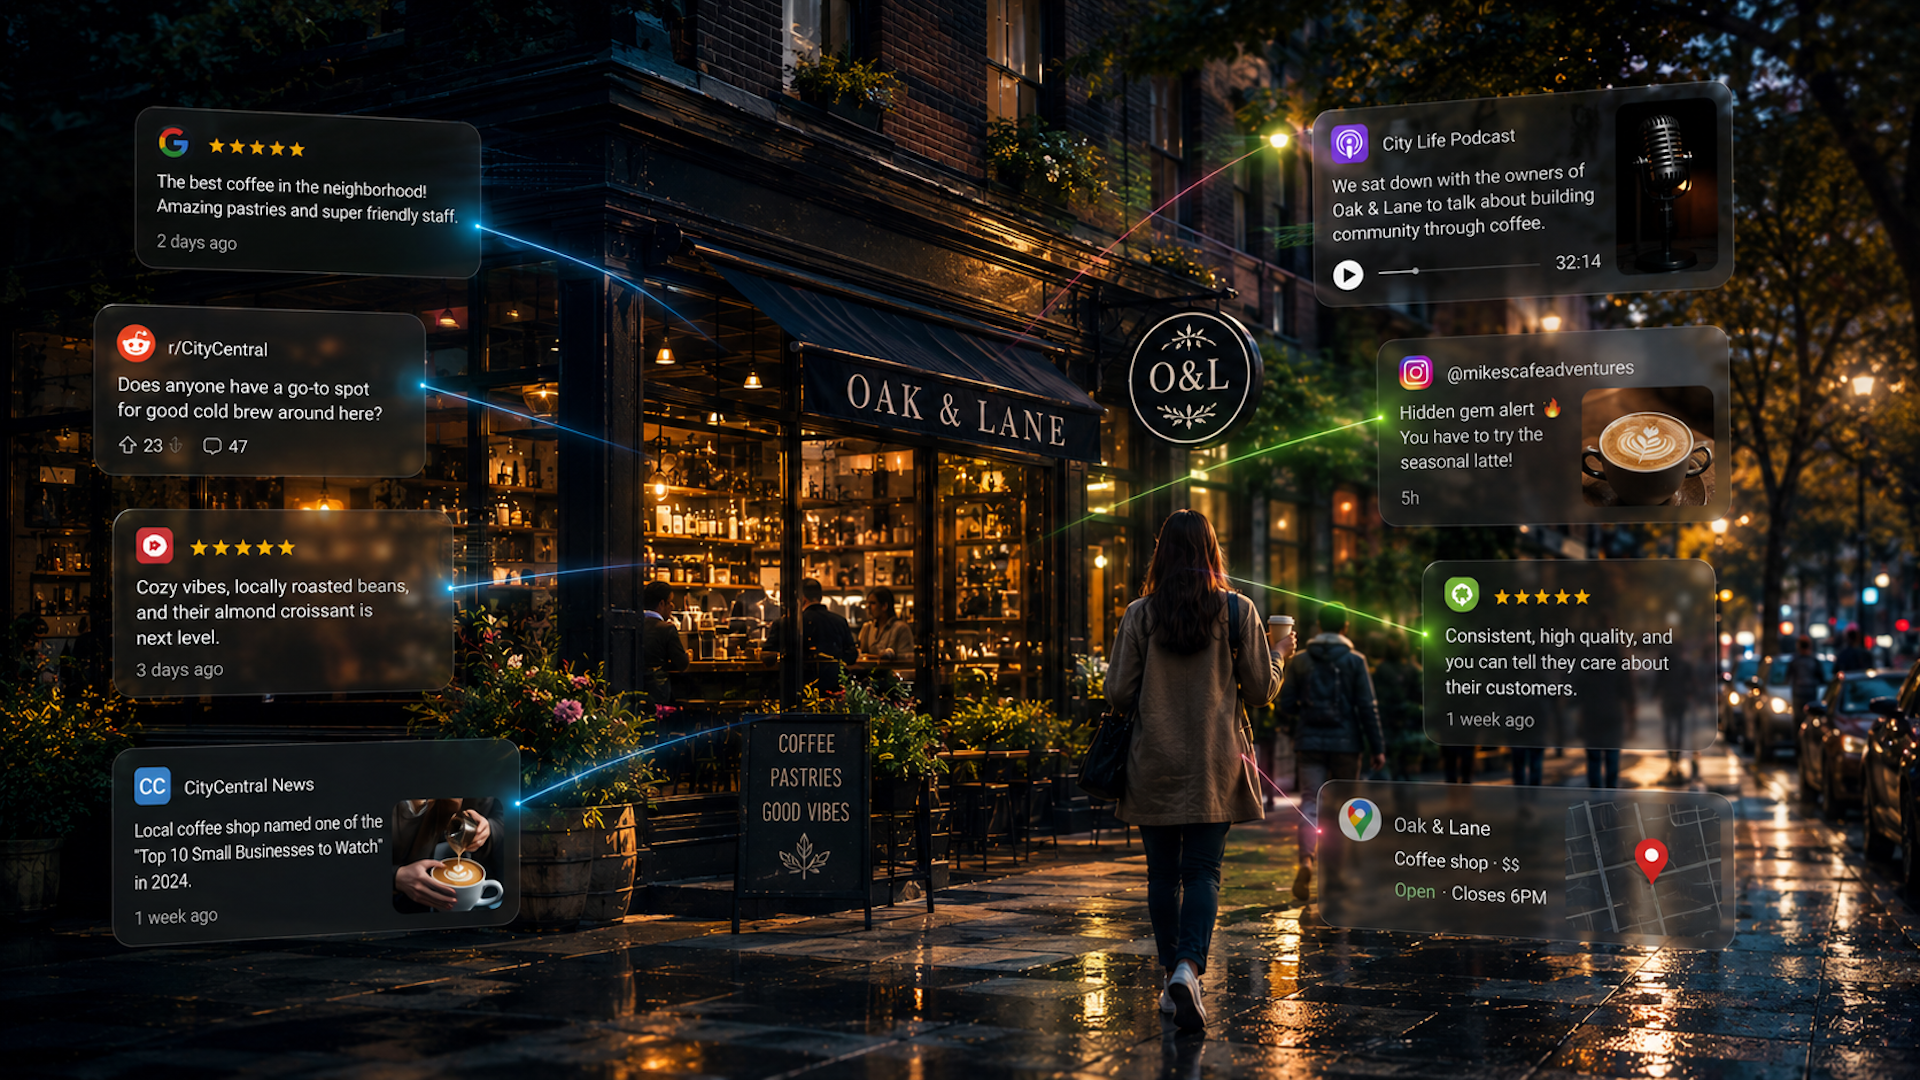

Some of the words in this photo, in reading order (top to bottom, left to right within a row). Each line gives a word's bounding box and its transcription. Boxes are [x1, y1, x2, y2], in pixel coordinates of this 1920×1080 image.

[1149, 357, 1230, 393] O&L
[846, 372, 925, 421] OAK
[939, 392, 962, 428] &
[977, 399, 1067, 447] LANE
[778, 733, 836, 754] COFFEE
[770, 767, 843, 788] PASTRIES
[762, 801, 801, 822] GOOD
[807, 801, 850, 822] VIBES
